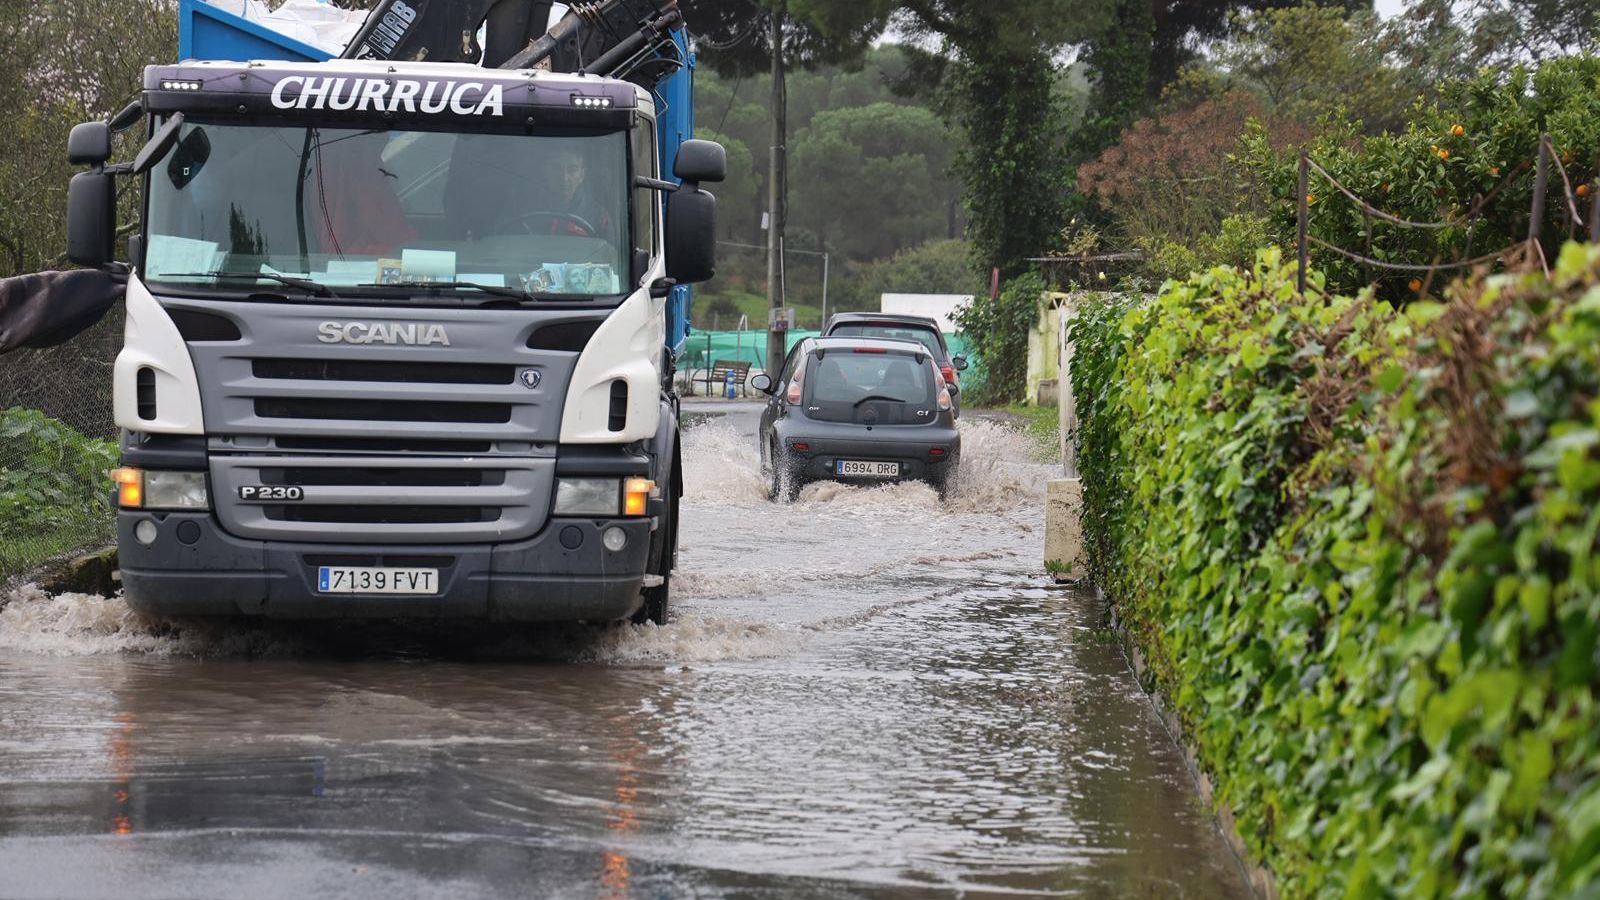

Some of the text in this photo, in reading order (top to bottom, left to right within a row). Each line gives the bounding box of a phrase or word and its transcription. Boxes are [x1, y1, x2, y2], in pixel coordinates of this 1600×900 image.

[369, 0, 417, 54] HIAB
[270, 75, 504, 117] CHURRUCA
[317, 320, 451, 346] SCANIA
[844, 462, 872, 473] 6994
[877, 463, 897, 474] DRG
[241, 486, 301, 499] P 230
[333, 570, 386, 590] 7139
[393, 571, 433, 590] FVT
